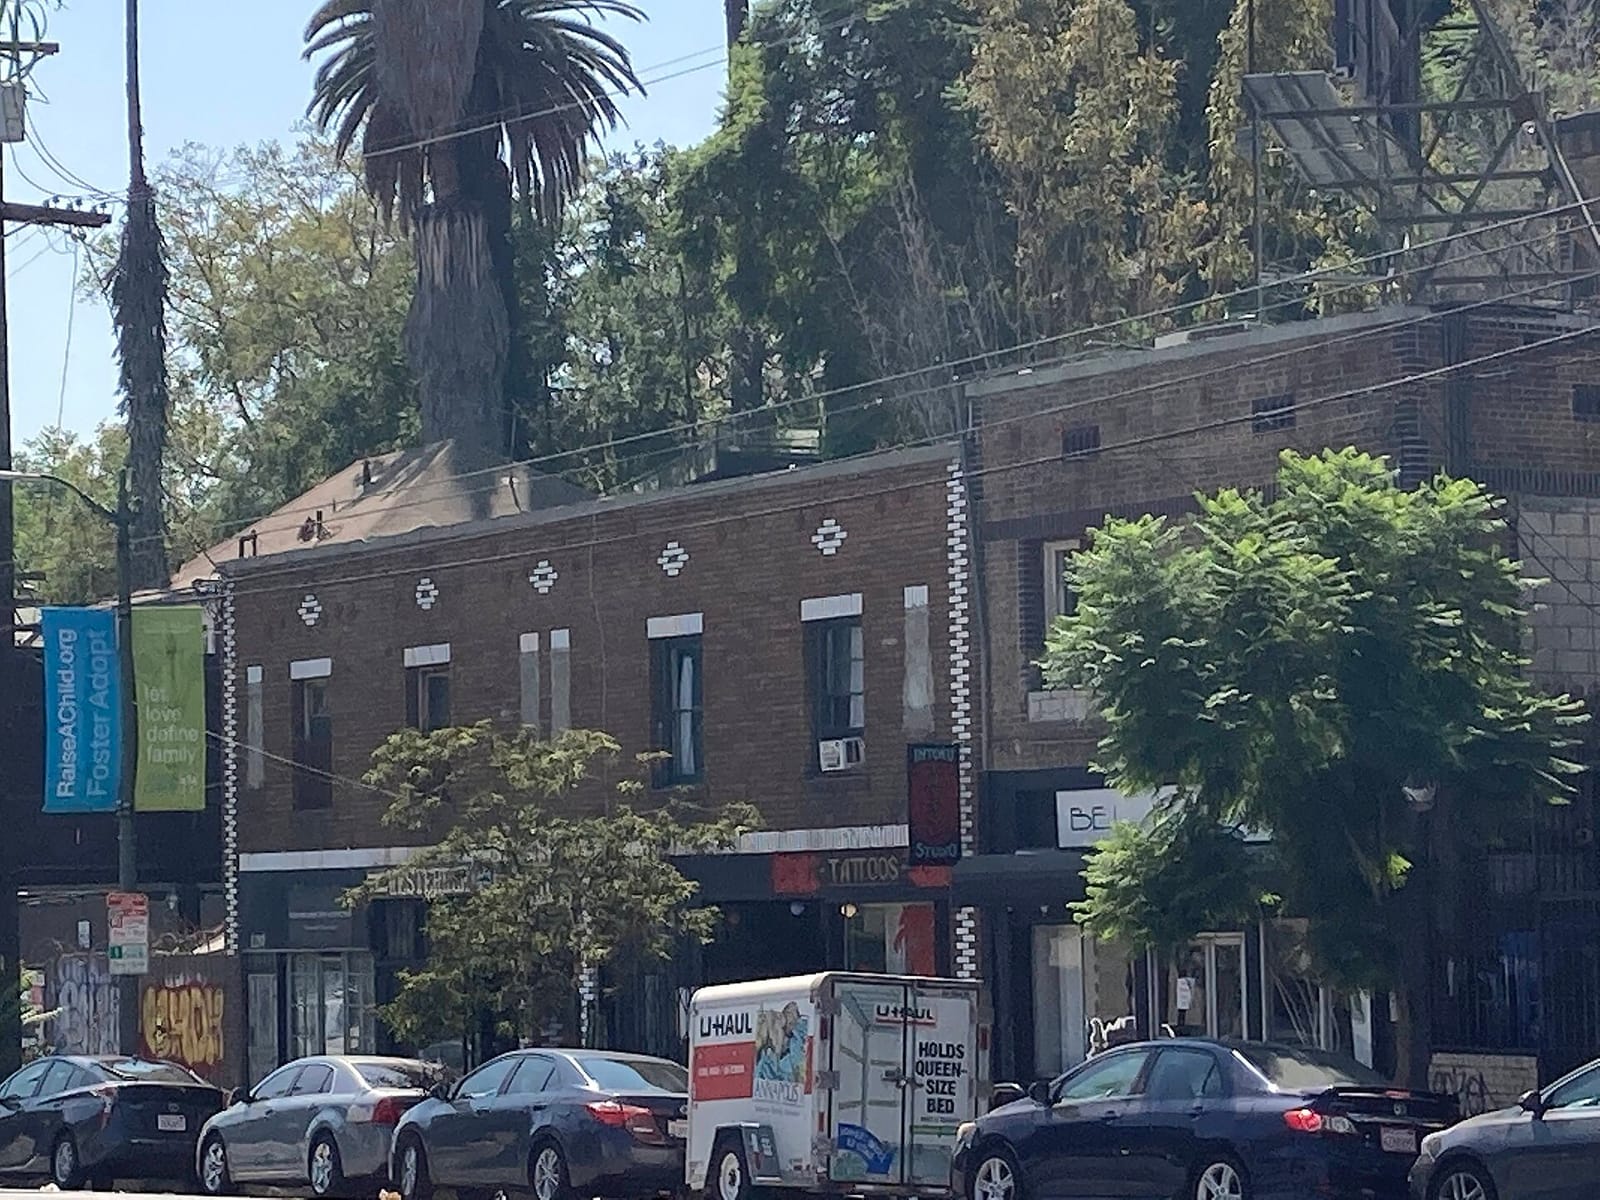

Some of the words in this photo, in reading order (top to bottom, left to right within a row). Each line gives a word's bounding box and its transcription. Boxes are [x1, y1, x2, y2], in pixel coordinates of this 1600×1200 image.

[88, 629, 114, 709] Adopt
[56, 628, 77, 798] RaiseAChild.org
[146, 705, 182, 723] love
[147, 726, 198, 743] define
[86, 712, 111, 797] Foster
[148, 744, 196, 766] family
[828, 856, 899, 882] TATTOOS
[876, 1004, 935, 1020] U-HAUL
[700, 1013, 752, 1037] U-HAUL
[918, 1041, 965, 1059] HOLDS
[915, 1060, 968, 1077] QUEEN-
[925, 1080, 957, 1096] SIZE
[926, 1098, 955, 1114] BED
